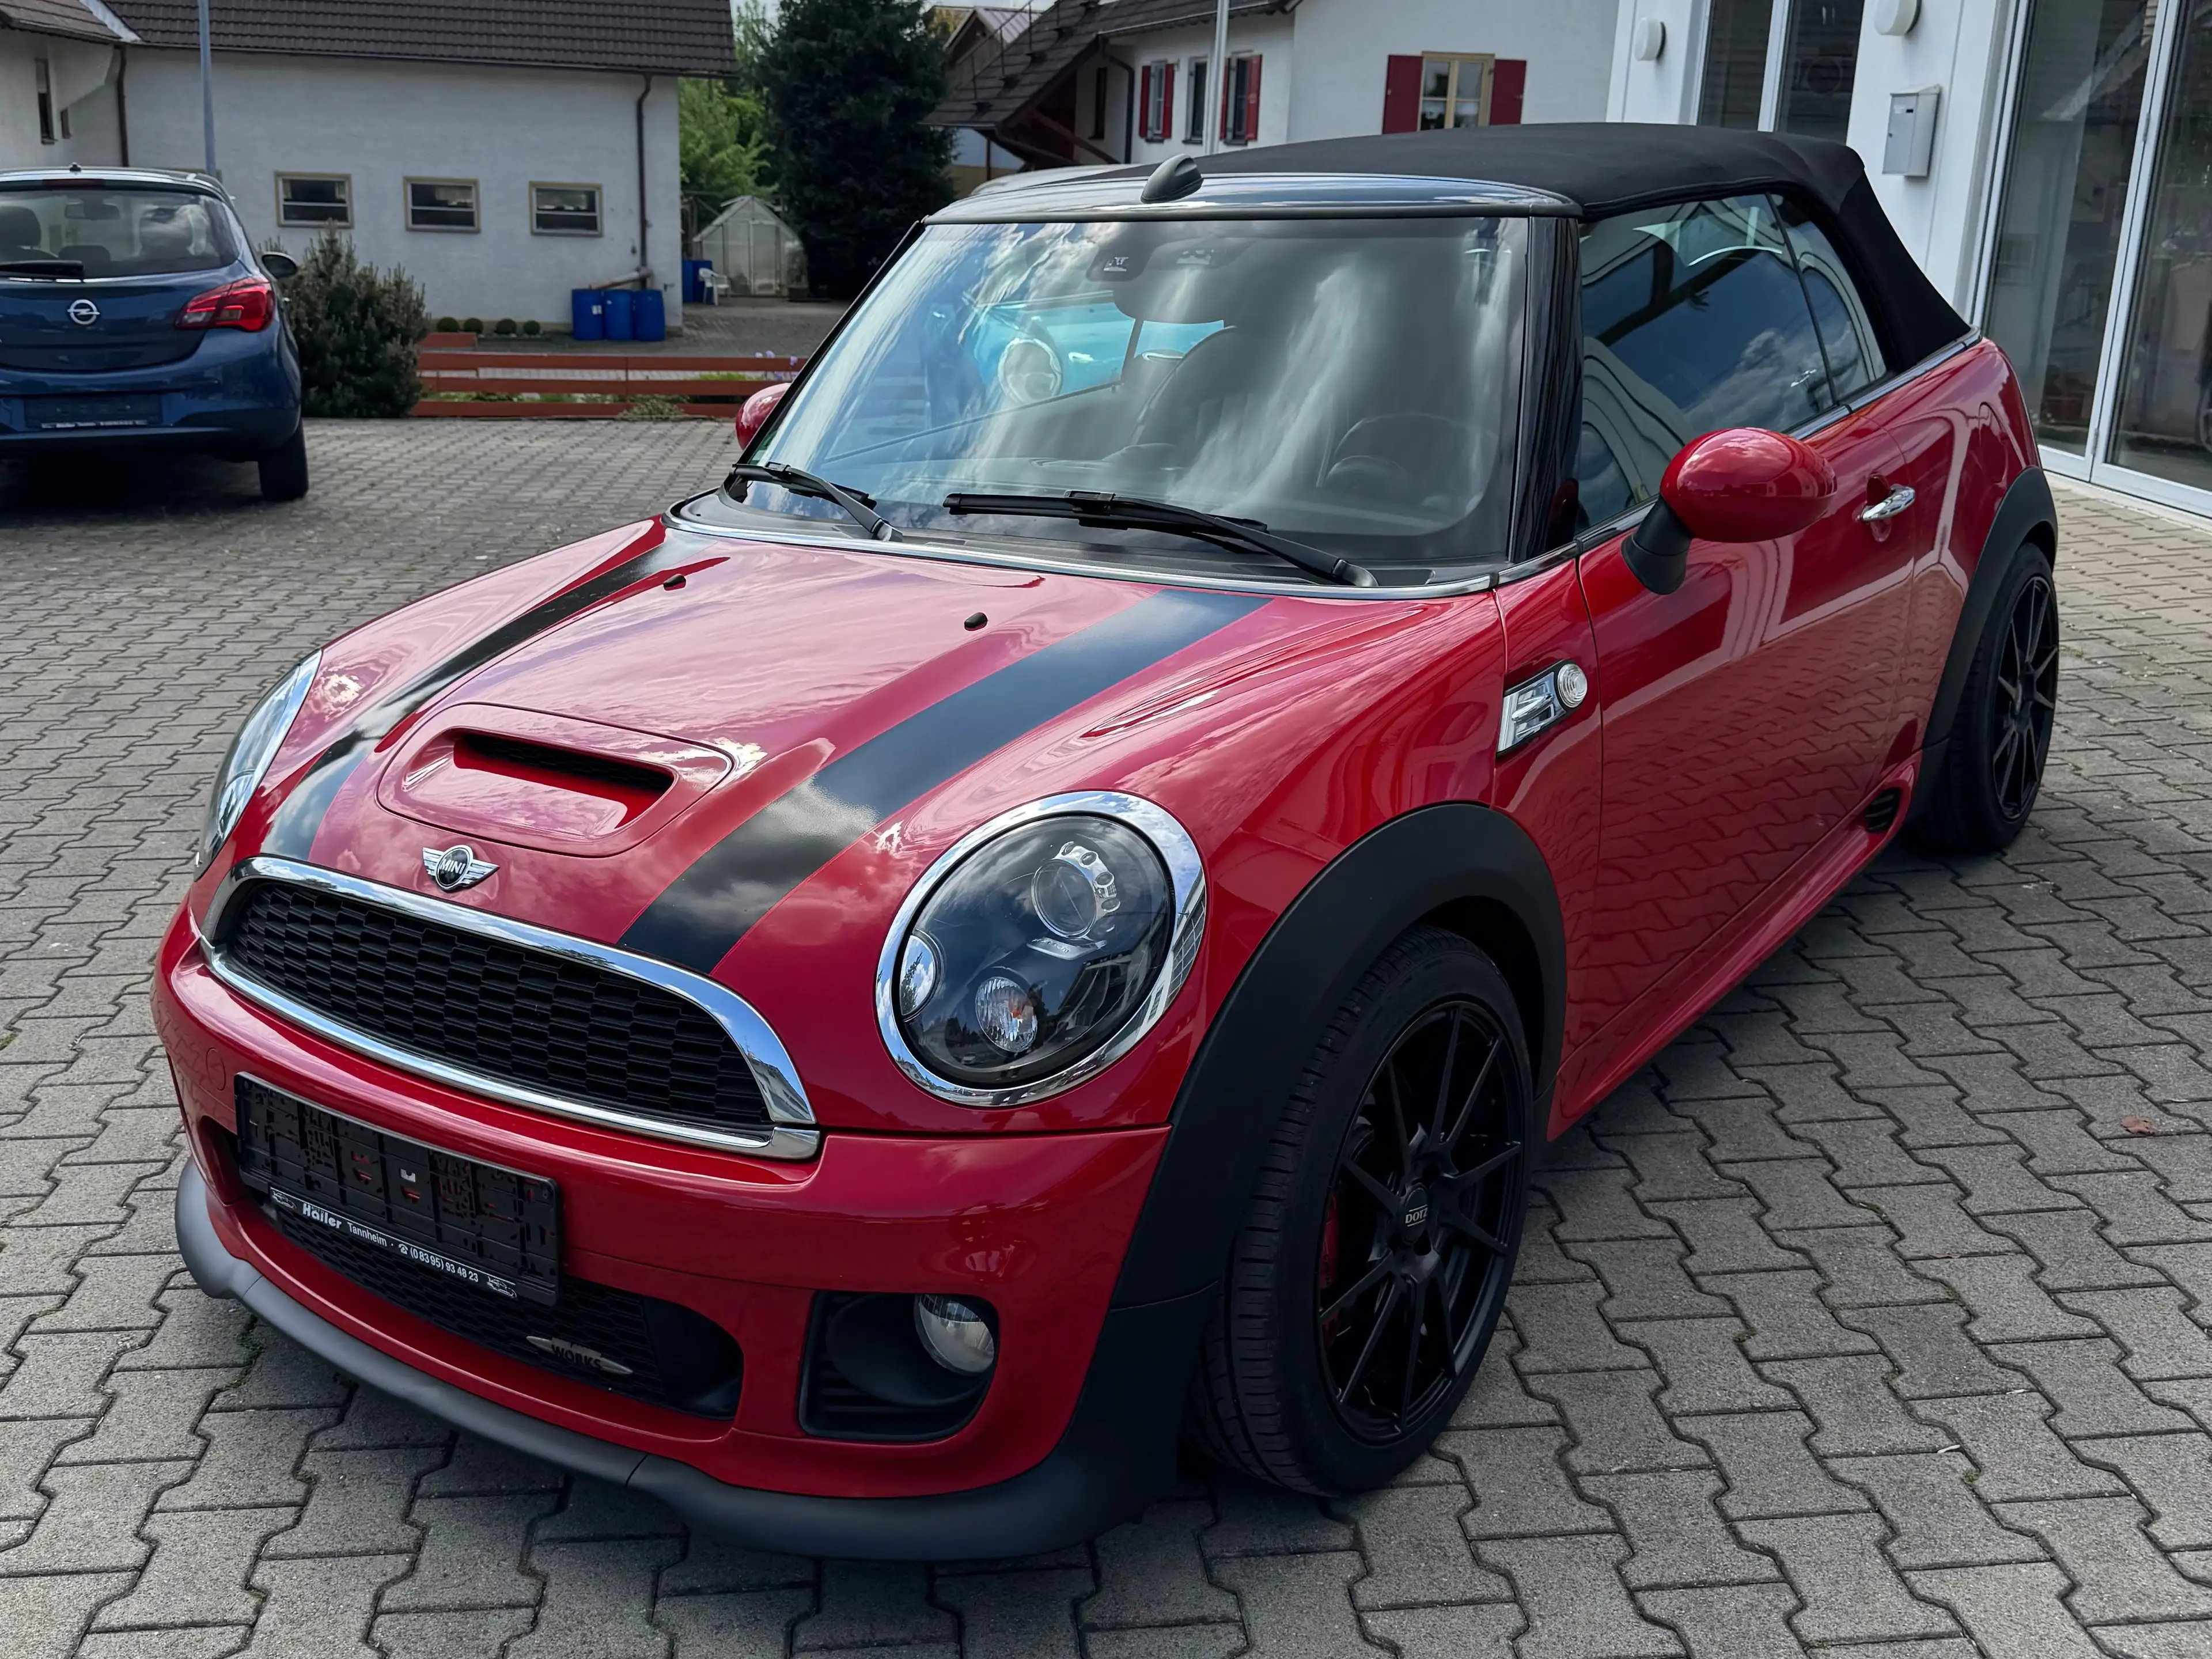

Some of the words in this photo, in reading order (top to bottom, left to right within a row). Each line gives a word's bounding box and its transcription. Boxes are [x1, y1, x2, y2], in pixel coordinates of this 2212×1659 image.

[440, 858, 466, 874] MINI
[1405, 1207, 1429, 1224] DOTZ
[347, 1221, 387, 1247] Tannheim
[446, 1262, 456, 1274] 93
[457, 1267, 467, 1278] 48
[468, 1271, 479, 1282] 23
[551, 1344, 601, 1369] WORKS
